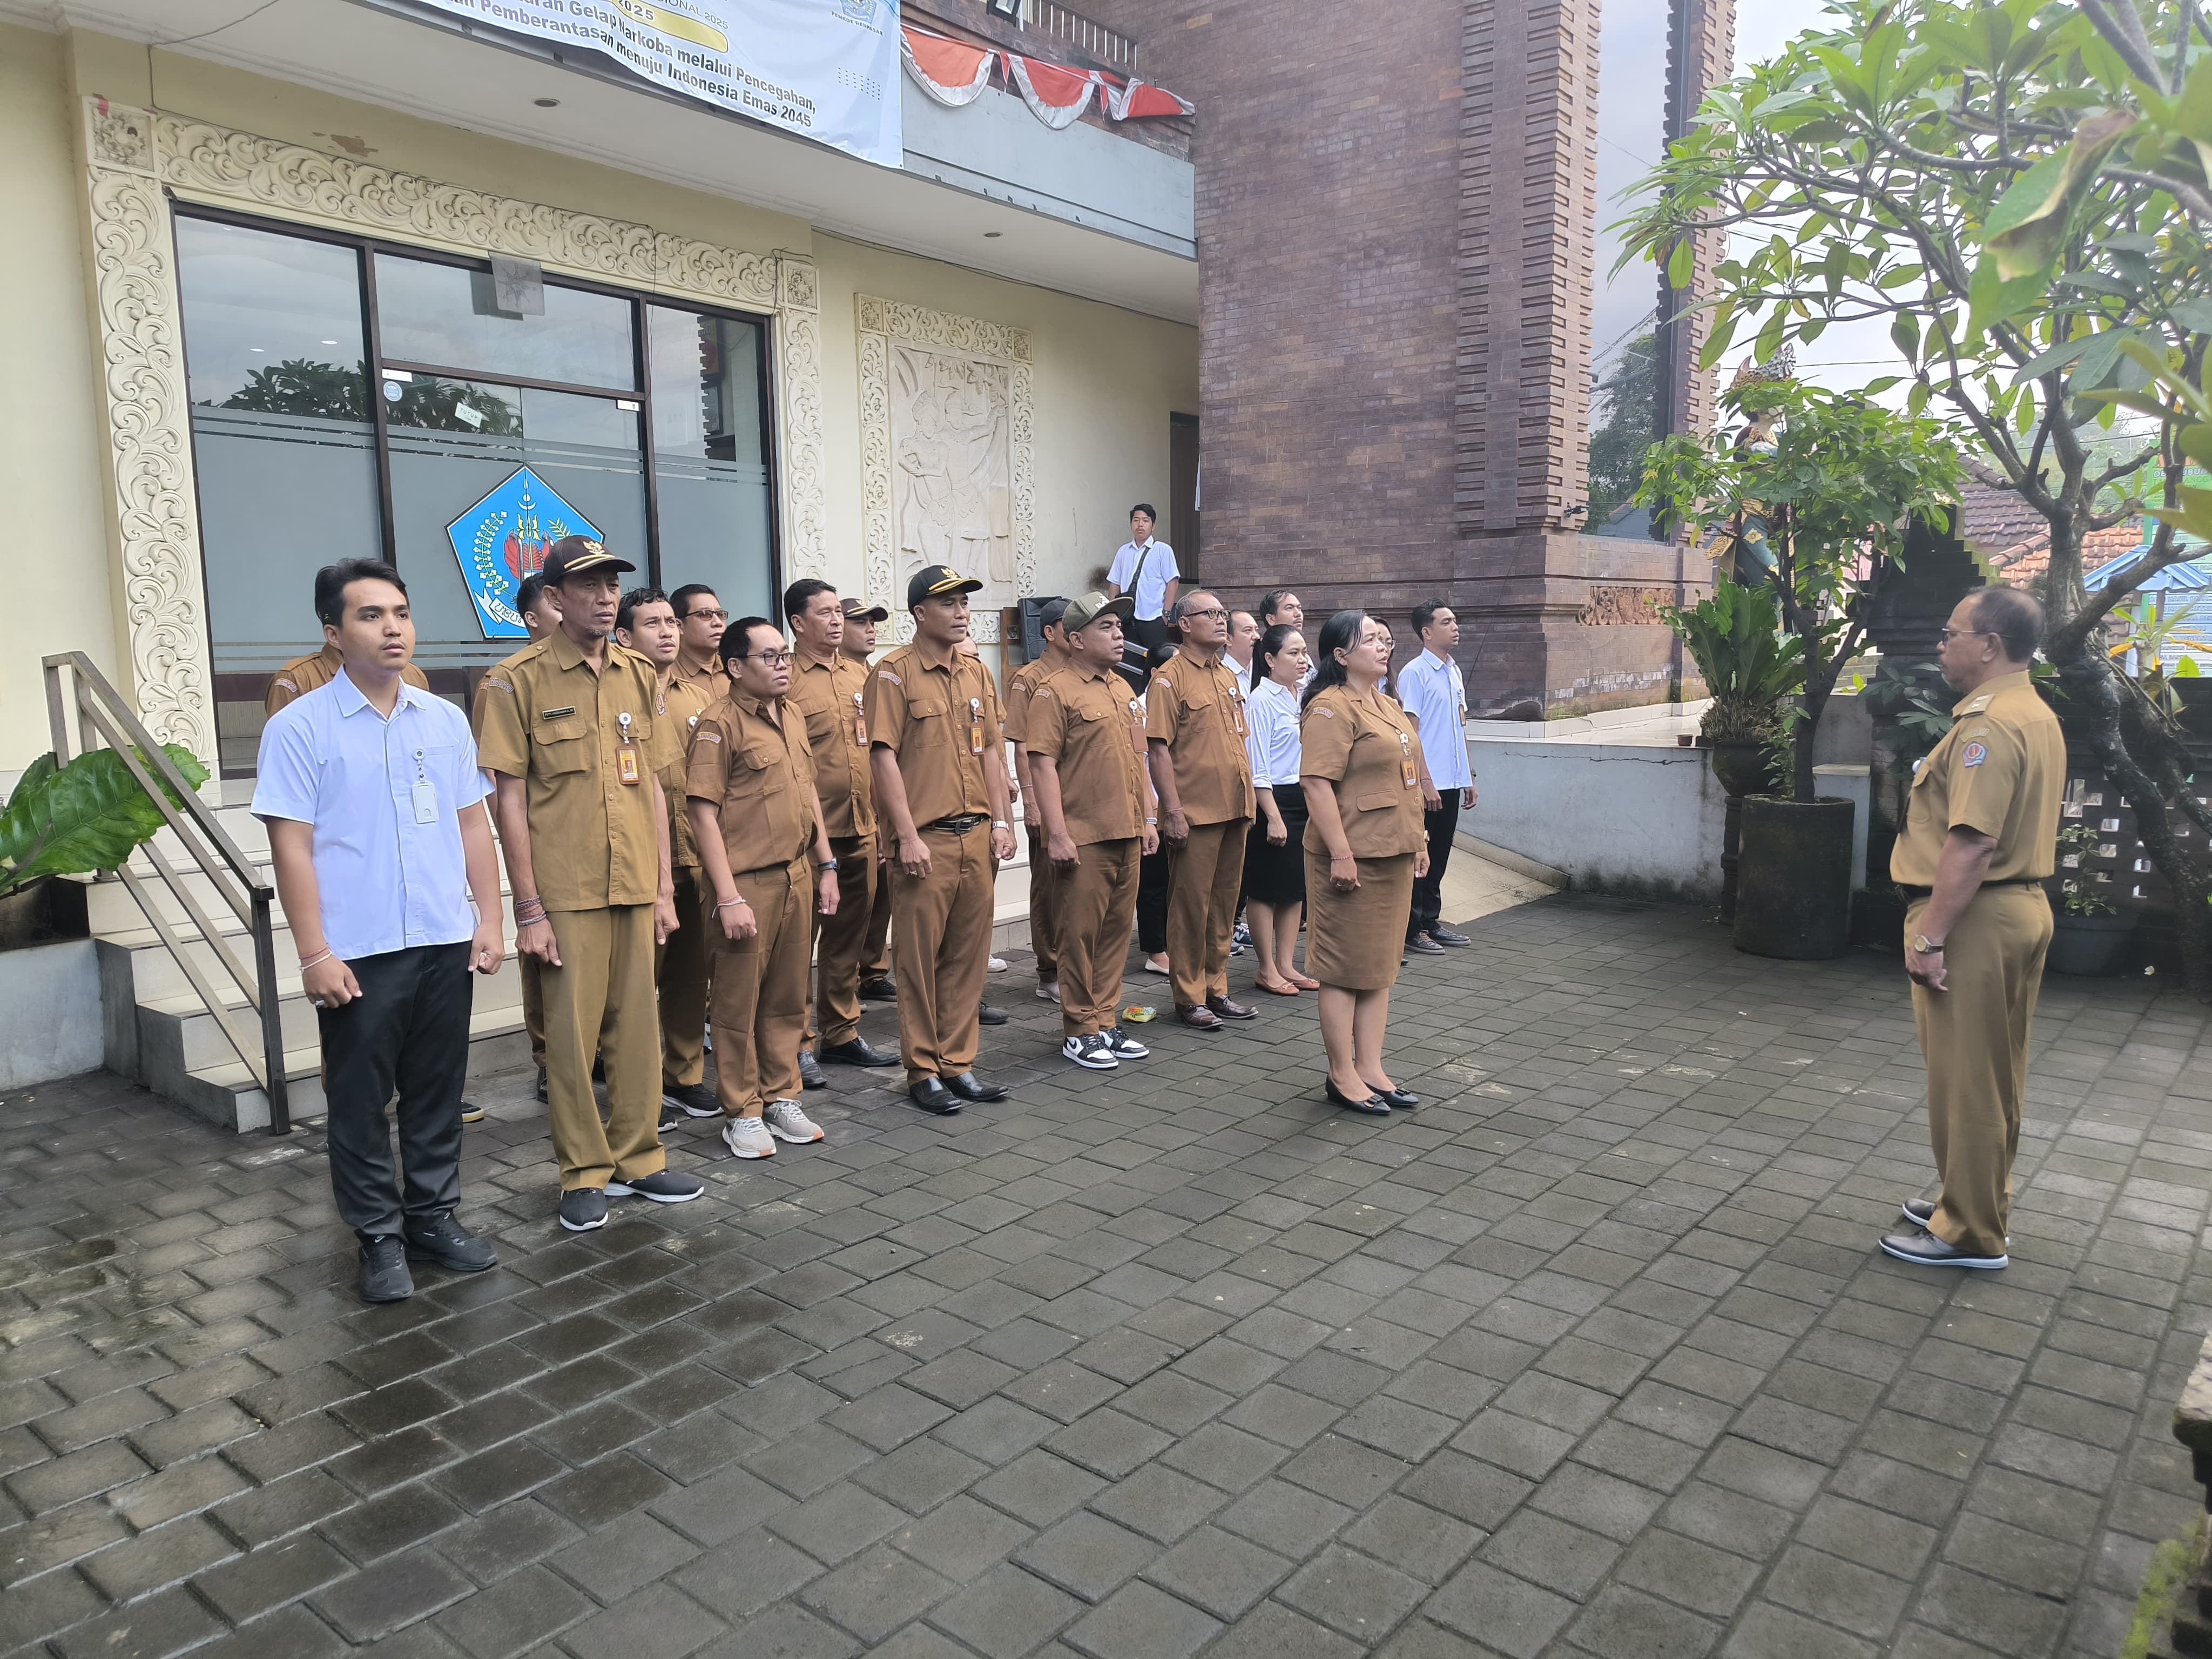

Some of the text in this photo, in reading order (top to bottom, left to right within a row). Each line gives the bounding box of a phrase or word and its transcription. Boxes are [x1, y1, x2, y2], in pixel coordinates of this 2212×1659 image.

[704, 12, 728, 29] 2025
[831, 11, 883, 36] PEMKOT DENPASAR
[481, 0, 614, 49] Pemberantasan
[616, 41, 663, 74] menuju
[667, 63, 738, 101] Indonesia
[743, 89, 778, 116] Emas
[780, 104, 812, 127] 2045
[569, 2, 616, 29] Gelap
[619, 17, 672, 56] Narkoba
[677, 49, 732, 77] melalui
[736, 66, 816, 114] Pencegahan,
[460, 408, 478, 419] TUTUP
[1233, 932, 1244, 941] N
